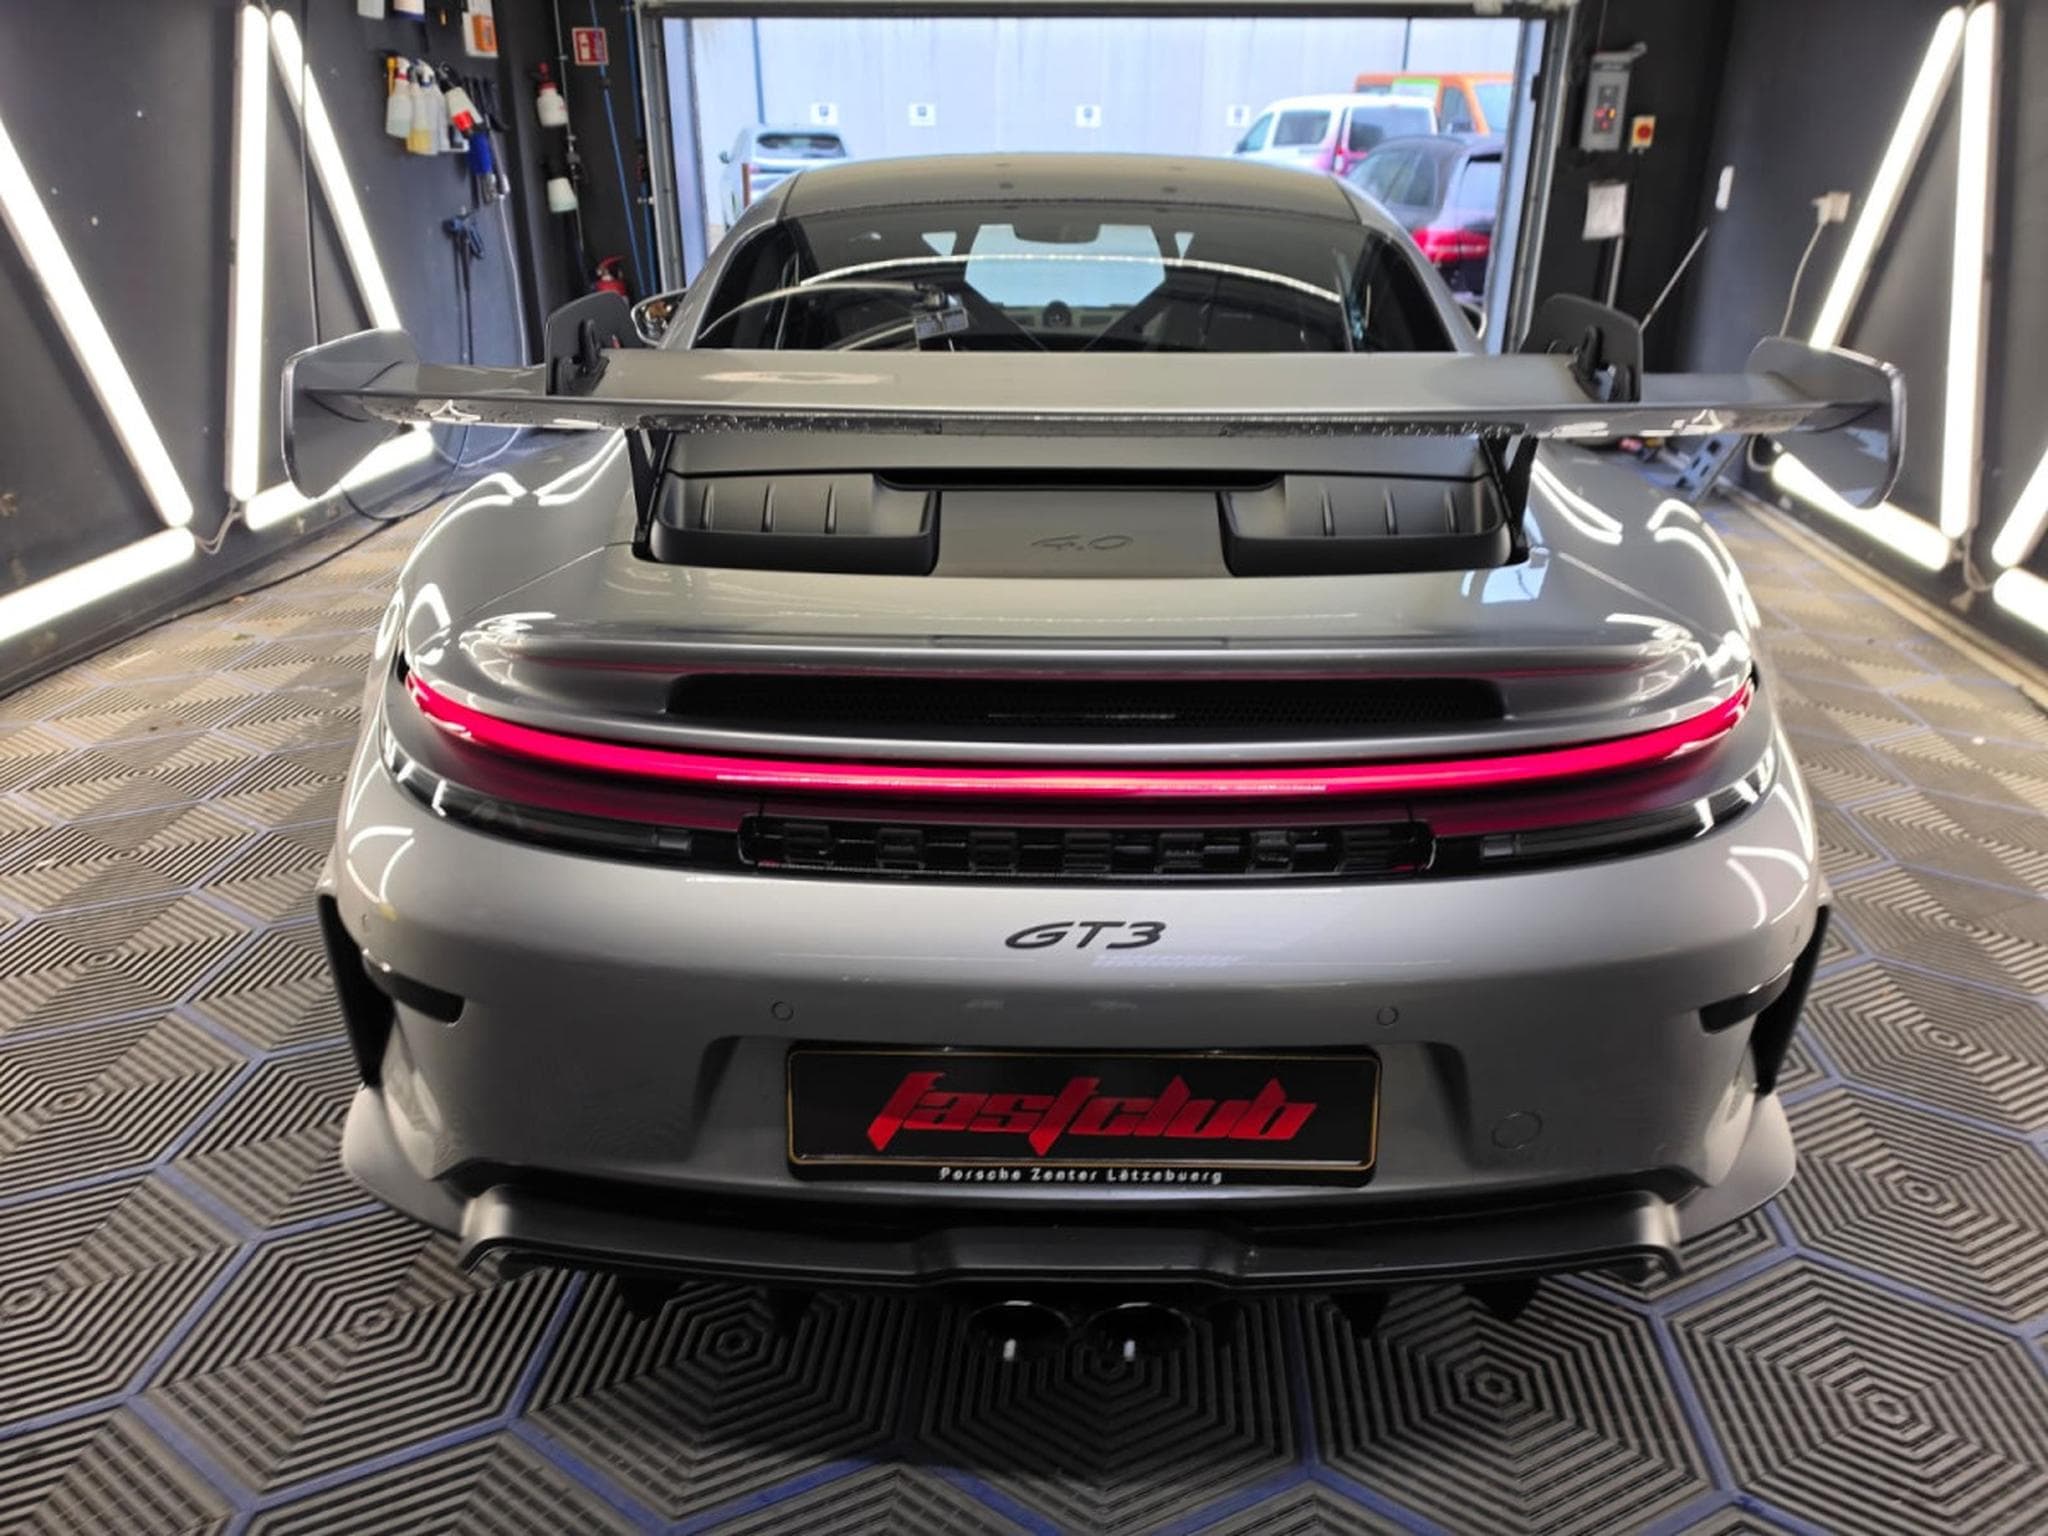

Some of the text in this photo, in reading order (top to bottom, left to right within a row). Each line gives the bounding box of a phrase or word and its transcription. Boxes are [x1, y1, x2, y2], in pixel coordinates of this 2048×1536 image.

[1004, 921, 1167, 950] GT3
[939, 1167, 1223, 1184] Porsche Zenter Lëtzebuerg
